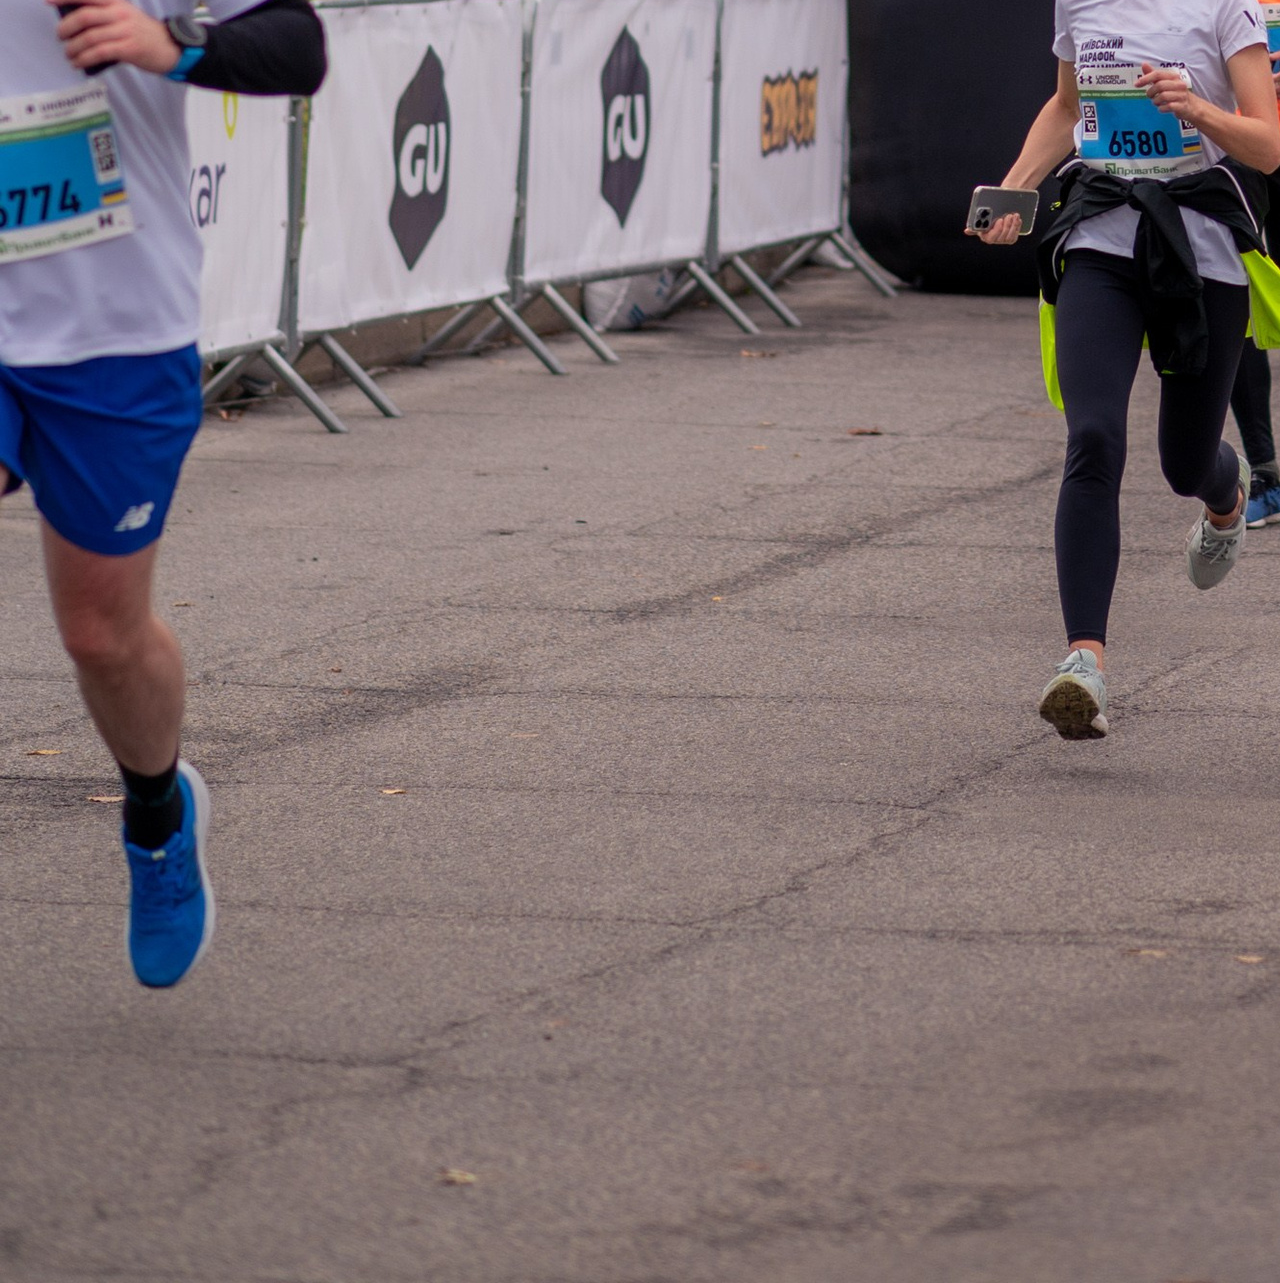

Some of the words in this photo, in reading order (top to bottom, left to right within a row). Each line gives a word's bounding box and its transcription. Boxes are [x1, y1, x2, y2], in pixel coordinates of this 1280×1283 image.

[1080, 36, 1124, 51] КИЇВСЬКИЙ
[1079, 50, 1116, 62] МАРАФОН
[606, 94, 646, 162] GU
[1108, 129, 1169, 157] 6580
[400, 122, 448, 197] GU
[1116, 165, 1179, 176] ПриватБанк
